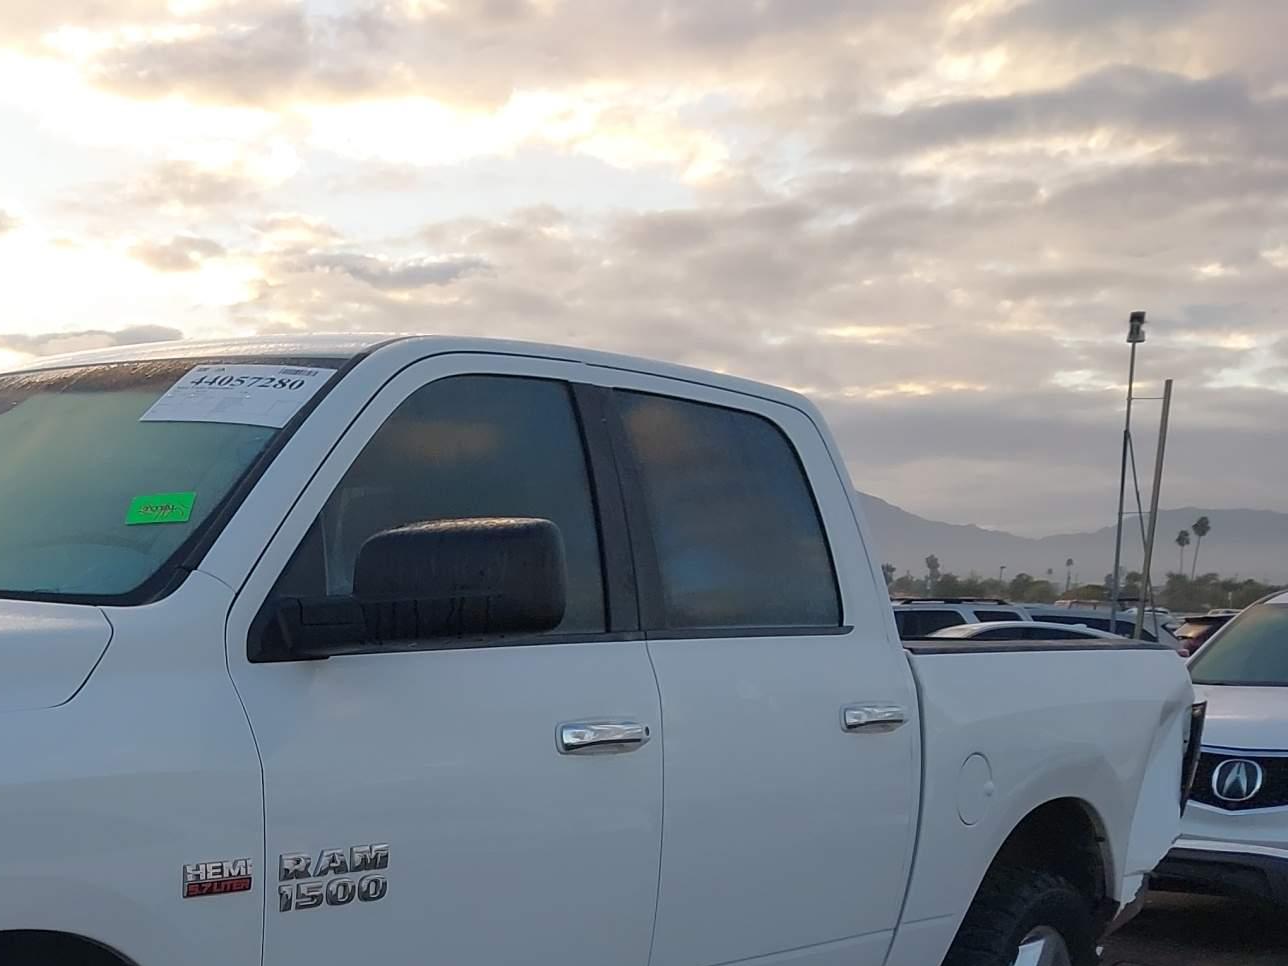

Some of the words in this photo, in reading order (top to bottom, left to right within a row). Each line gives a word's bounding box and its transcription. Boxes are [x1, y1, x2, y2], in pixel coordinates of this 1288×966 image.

[190, 374, 305, 391] 44057280
[186, 858, 253, 881] HEMI
[279, 843, 390, 881] RAM
[213, 878, 249, 893] LITER
[277, 874, 389, 912] 1500
